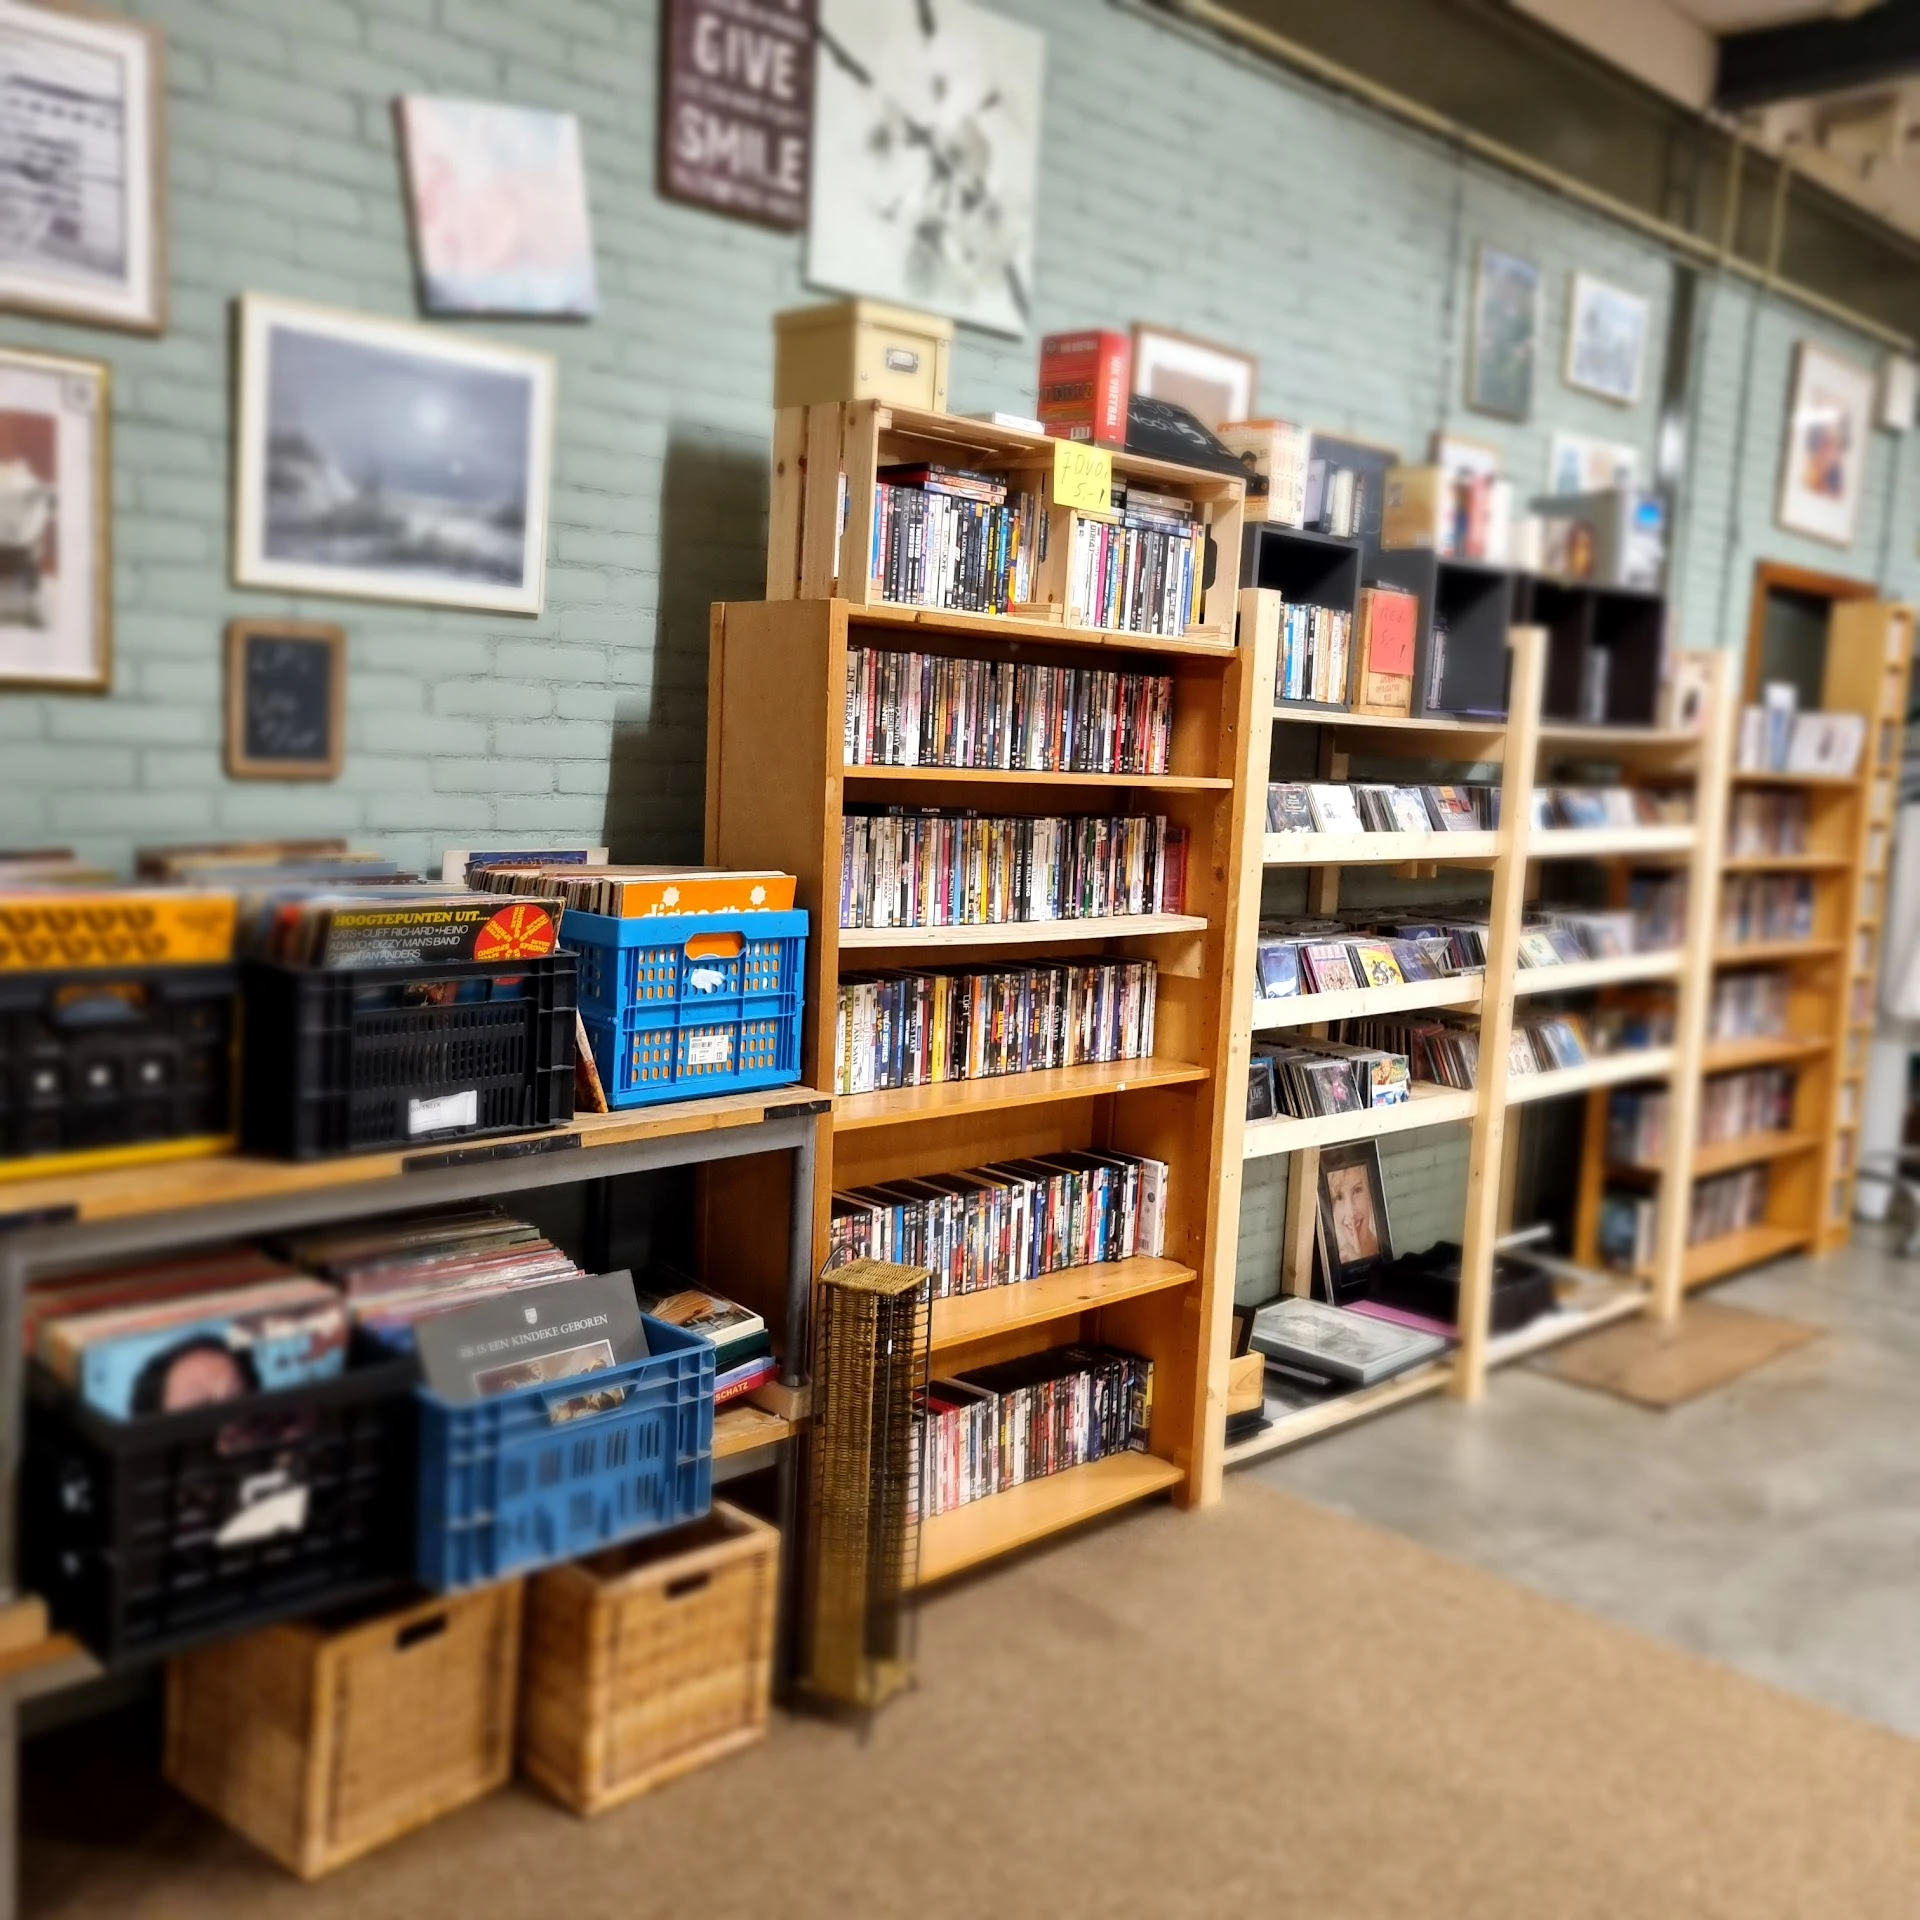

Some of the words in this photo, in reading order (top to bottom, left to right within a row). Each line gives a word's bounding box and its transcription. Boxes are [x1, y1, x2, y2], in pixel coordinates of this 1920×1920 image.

[693, 14, 796, 101] GIVE
[676, 103, 802, 192] SMILE
[1062, 451, 1072, 485] 7
[848, 669, 855, 682] IN
[844, 690, 853, 747] THERAPIE
[893, 707, 901, 747] DOROTHY
[948, 869, 956, 908] DOROTHY
[1014, 866, 1022, 898] KILLING
[334, 913, 455, 927] HOOGTEPUNTEN
[391, 925, 434, 937] RICHARD
[372, 938, 402, 949] DIZZY
[432, 936, 460, 947] BAND
[882, 1010, 891, 1031] WILD
[1053, 1005, 1061, 1041] CURSED
[882, 1032, 890, 1063] SERIES
[488, 1338, 510, 1354] EEN
[510, 1326, 560, 1347] KINDEKE
[559, 1313, 609, 1335] GEBOREN
[714, 1381, 750, 1402] SCHATZ
